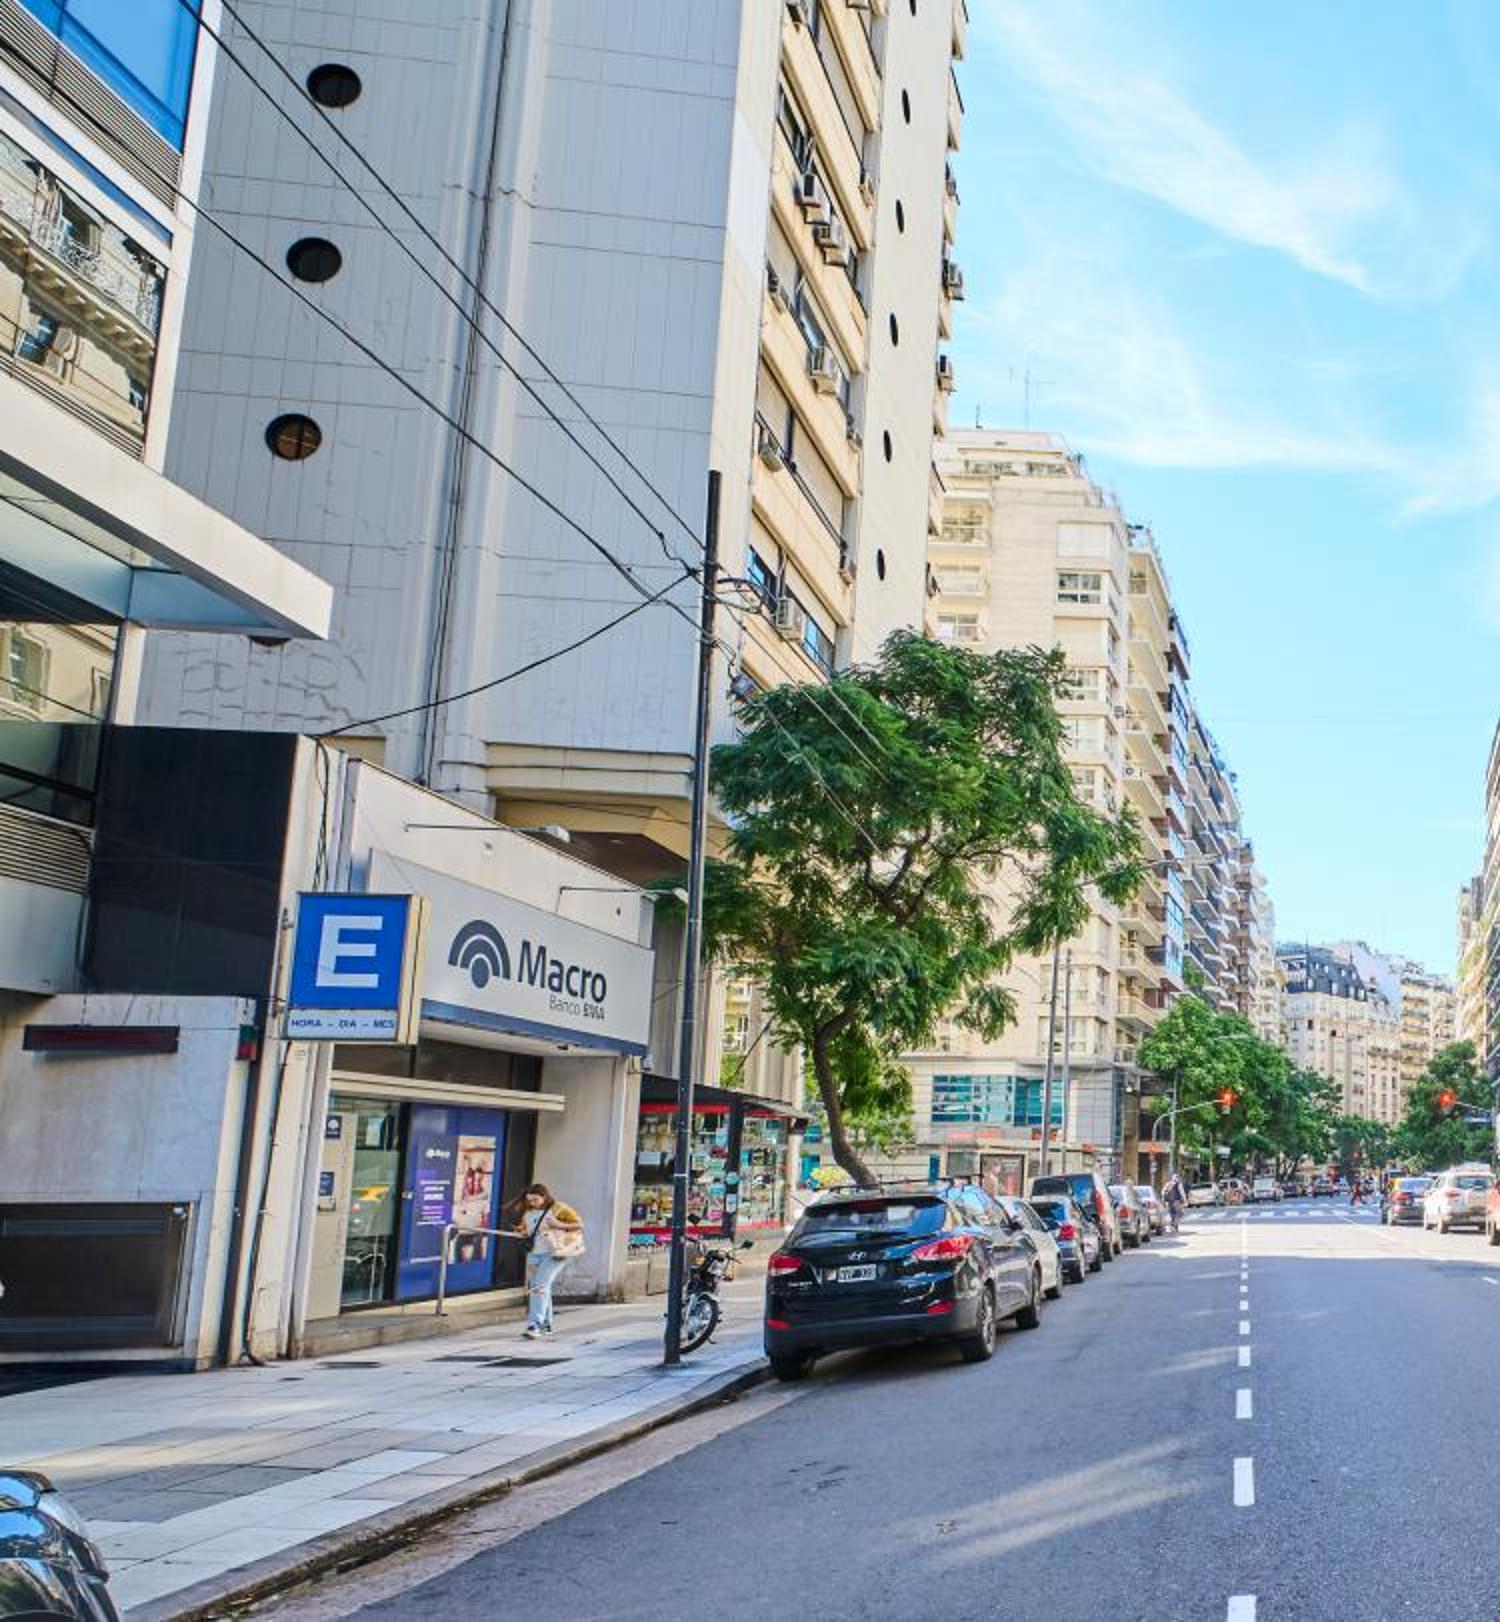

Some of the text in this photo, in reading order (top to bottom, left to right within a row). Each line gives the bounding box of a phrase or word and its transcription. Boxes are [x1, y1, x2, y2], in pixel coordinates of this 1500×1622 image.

[315, 914, 384, 989] E
[517, 938, 607, 1004] Macro
[550, 994, 580, 1016] Banco
